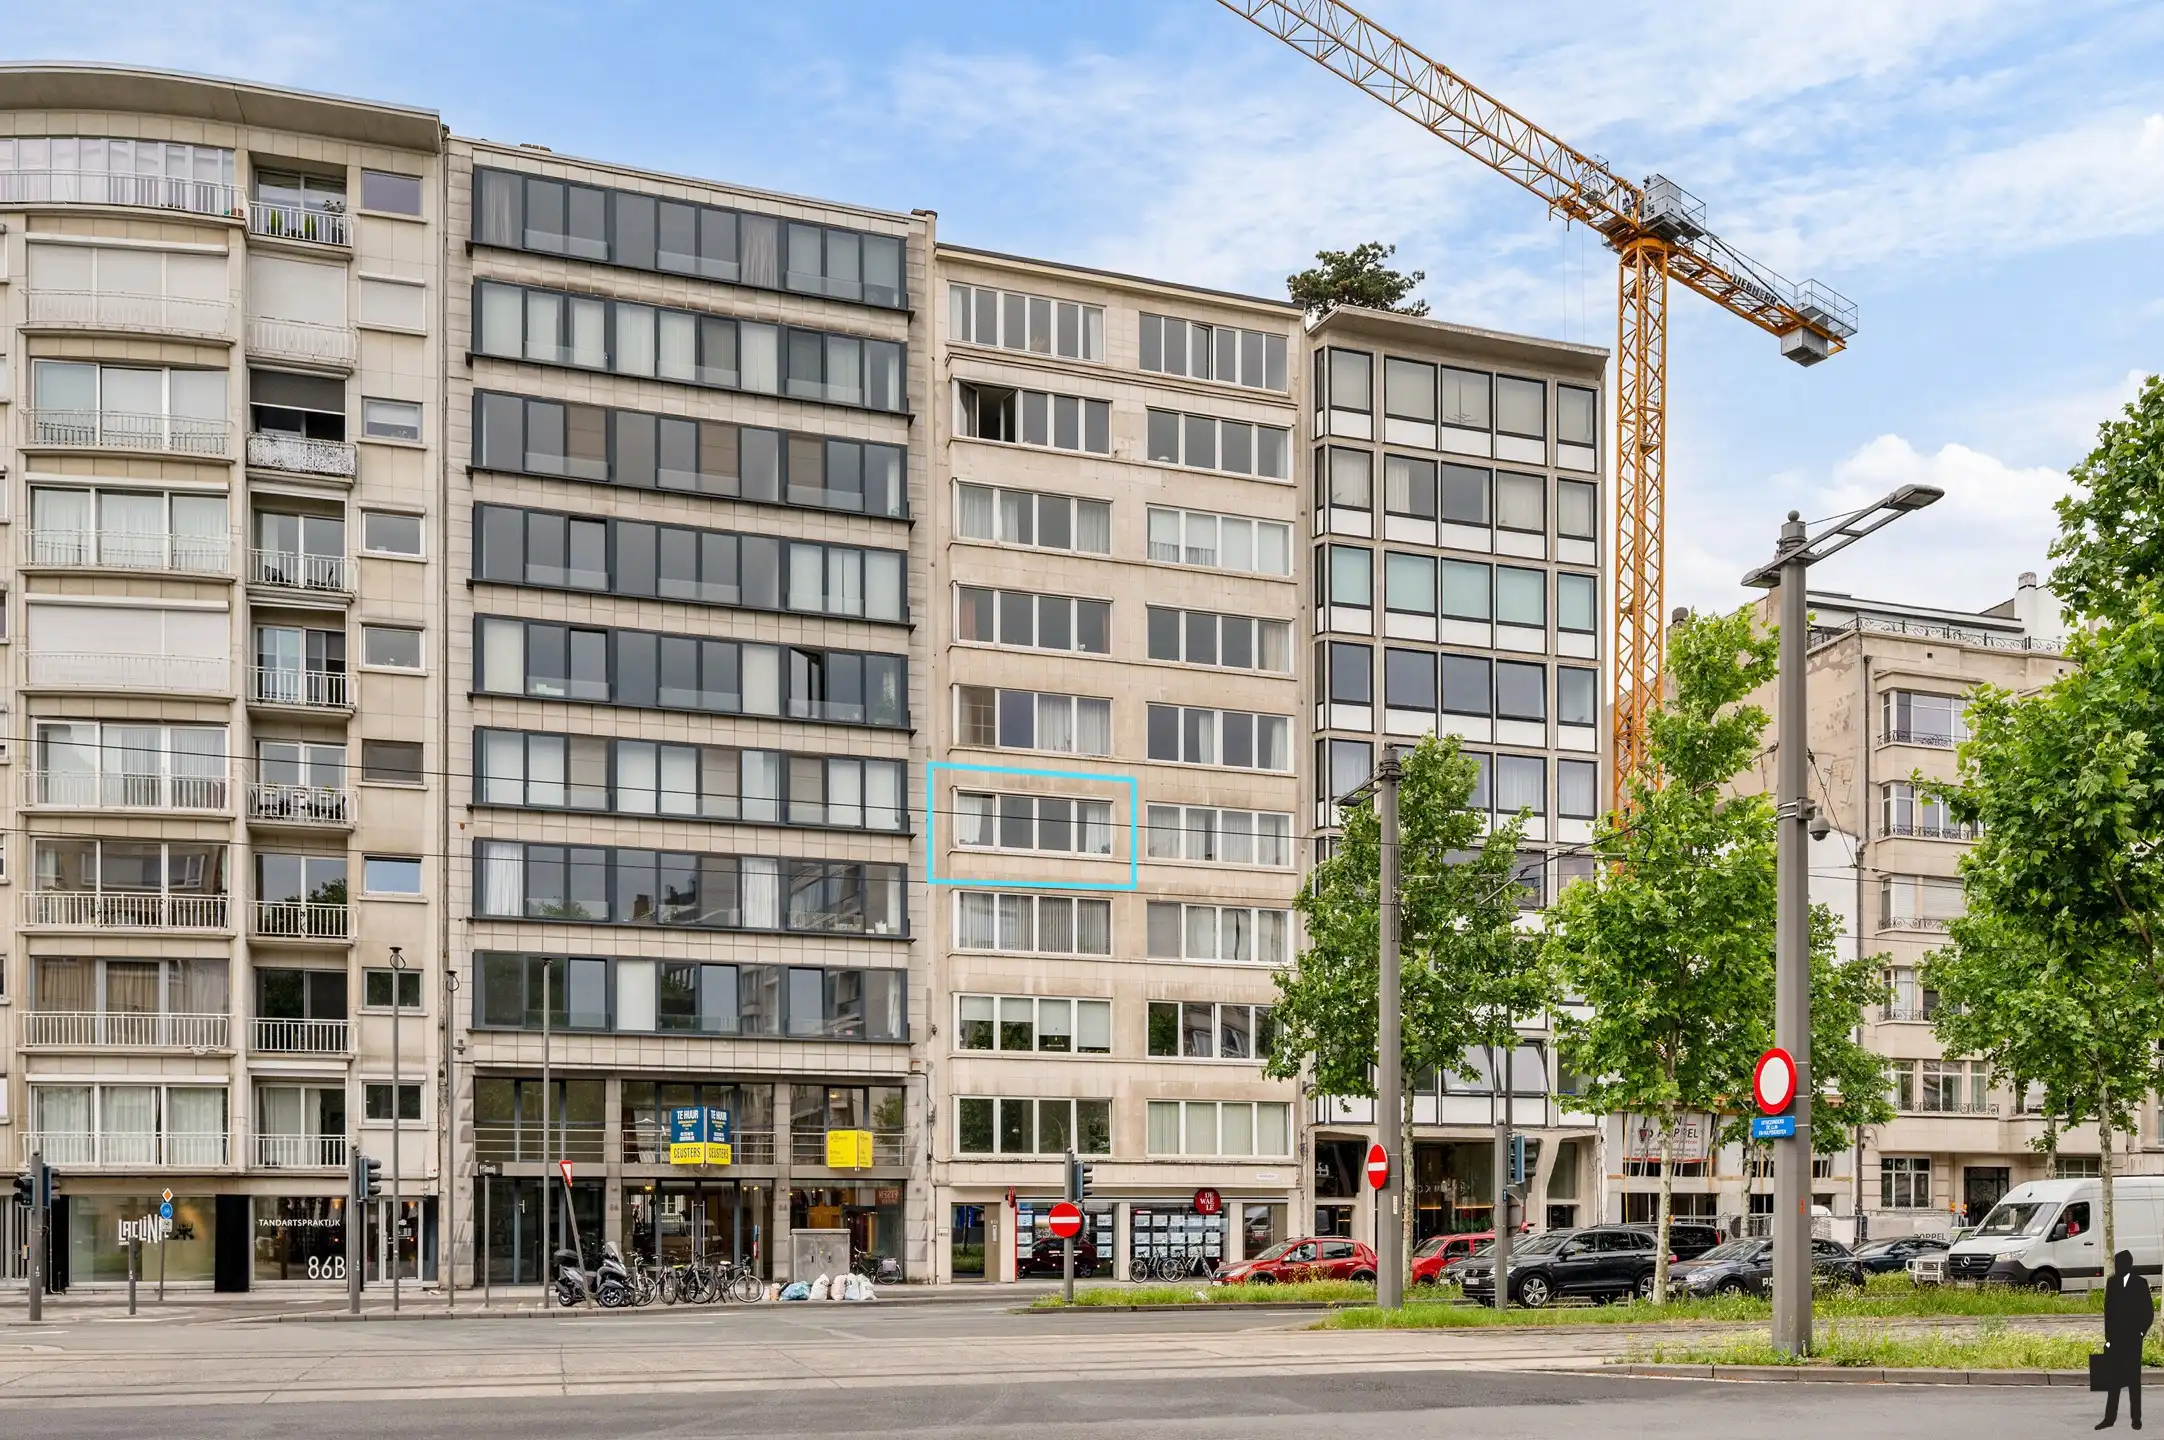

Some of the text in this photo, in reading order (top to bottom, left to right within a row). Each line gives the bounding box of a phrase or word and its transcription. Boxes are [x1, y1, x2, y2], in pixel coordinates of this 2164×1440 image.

[1732, 274, 1777, 306] LIEBHERR
[677, 1110, 698, 1119] TE HUUR
[711, 1110, 727, 1121] TE HUUR
[674, 1147, 700, 1158] CEUSTERS
[708, 1147, 729, 1159] CEUSTERS
[258, 1219, 341, 1227] TANDARTSPRAKTIJK
[307, 1255, 346, 1279] 86B
